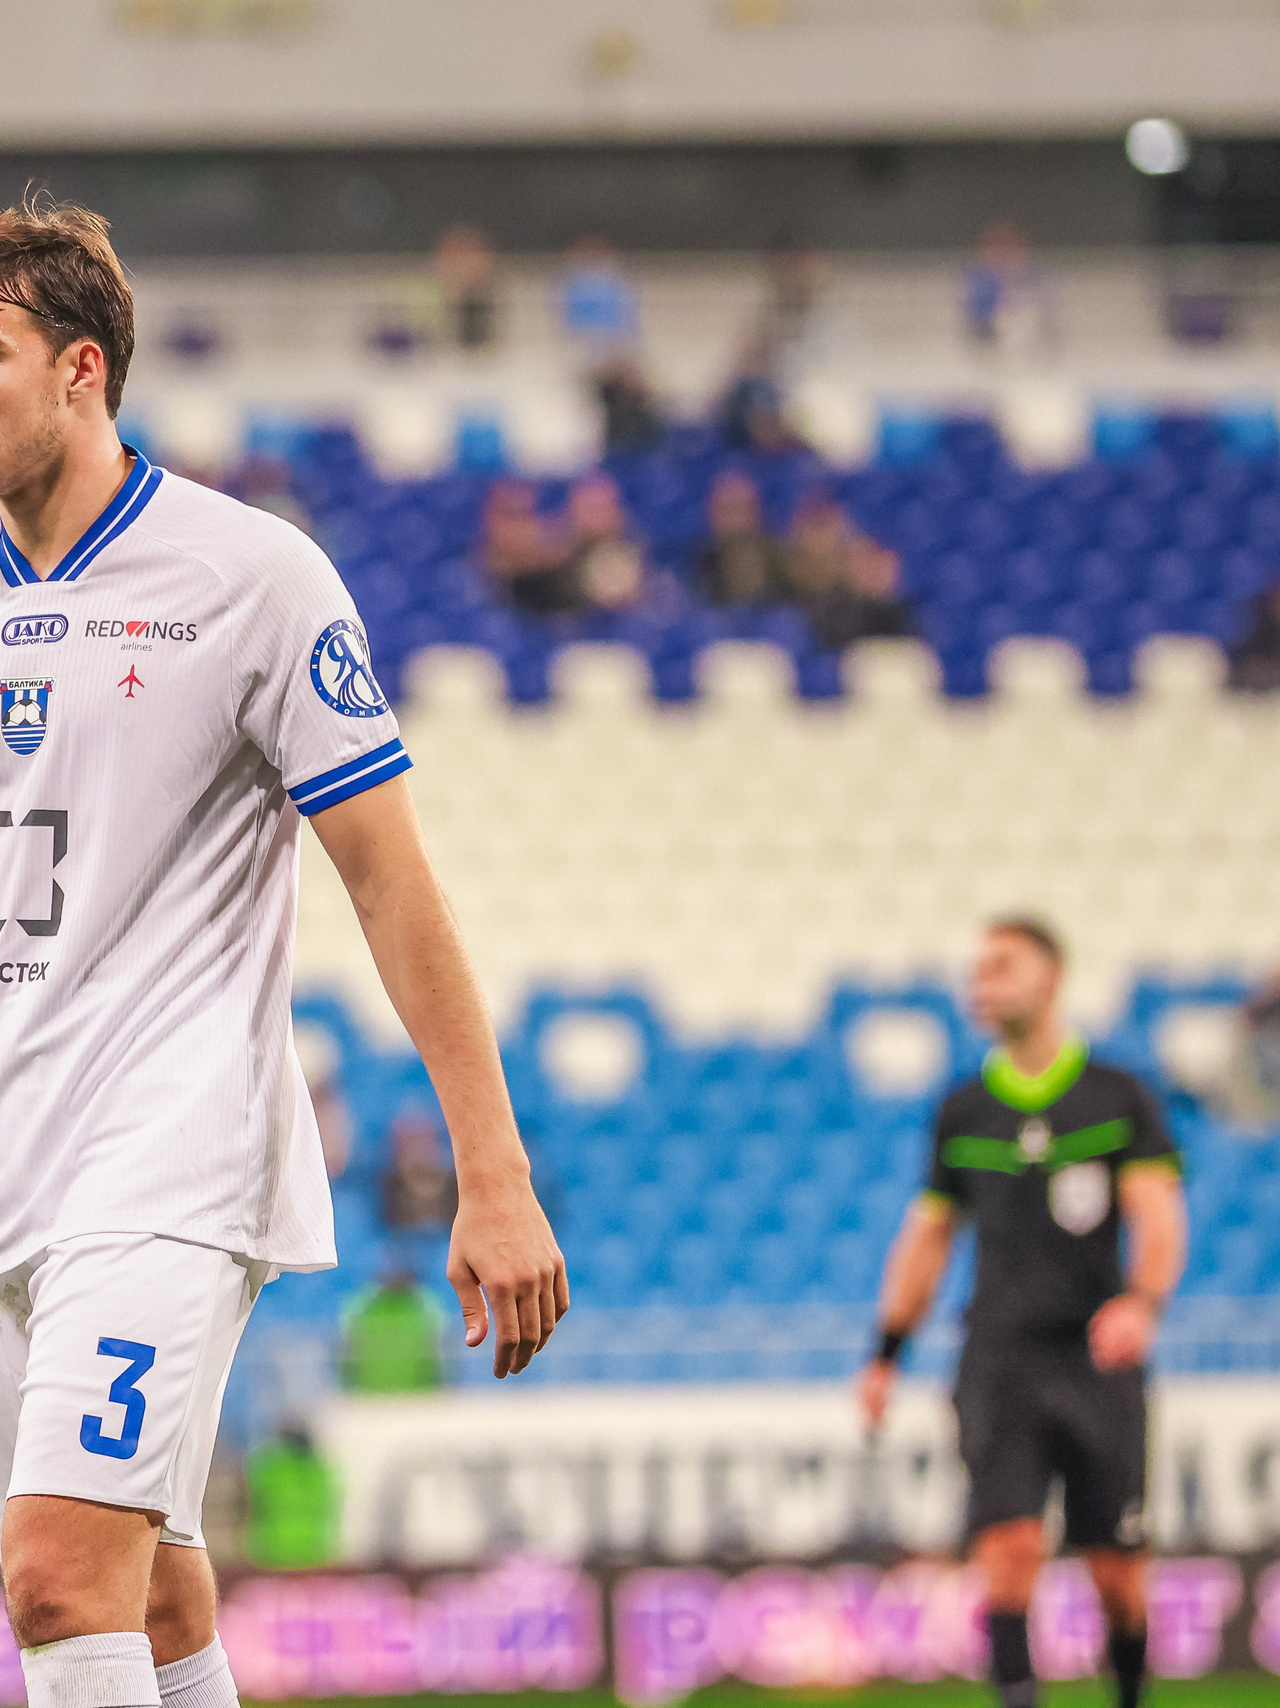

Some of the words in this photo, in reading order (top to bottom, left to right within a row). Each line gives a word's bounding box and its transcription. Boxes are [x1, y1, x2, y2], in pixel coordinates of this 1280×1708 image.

[8, 619, 64, 639] JAKO
[21, 637, 44, 645] SPORT
[121, 642, 153, 652] airlines
[8, 680, 44, 689] БАЛТИКА
[332, 701, 388, 716] КОМБИ
[80, 1336, 156, 1459] 3
